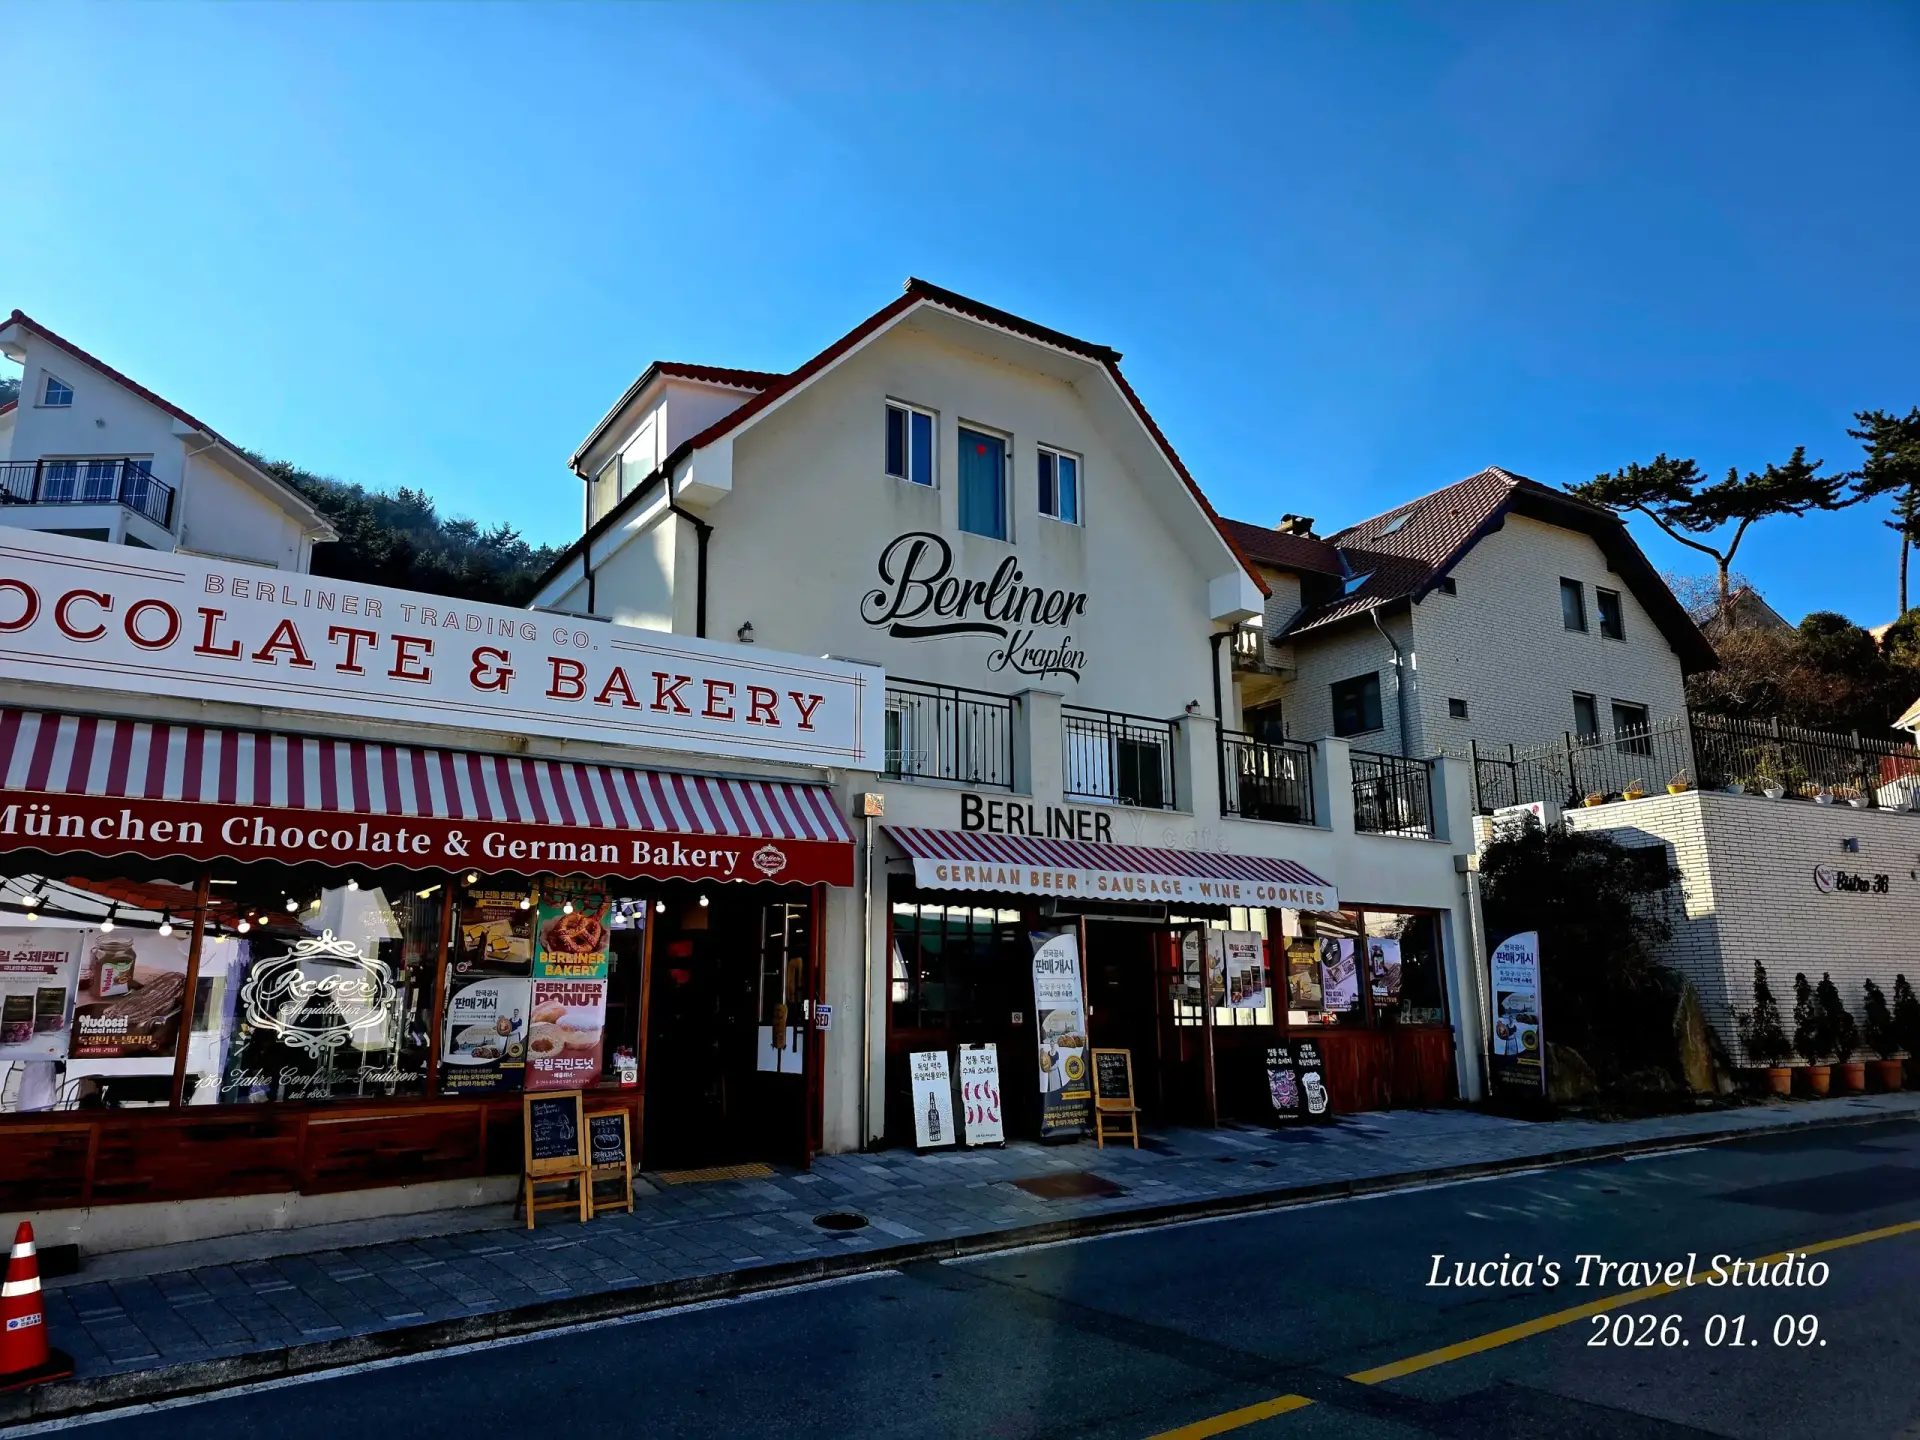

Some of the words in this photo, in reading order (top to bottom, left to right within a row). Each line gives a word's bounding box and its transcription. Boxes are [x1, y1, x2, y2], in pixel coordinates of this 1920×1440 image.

[860, 532, 1090, 638] Berliner
[205, 574, 382, 618] BERLINER
[401, 603, 537, 641] TRADING
[552, 627, 599, 650] CO.
[987, 630, 1087, 684] Krapfen
[469, 646, 515, 694] &
[545, 656, 825, 731] BAKERY
[960, 793, 1113, 844] BERLINER
[221, 816, 431, 855] Chocolate
[443, 829, 470, 857] &
[482, 831, 618, 865] German
[630, 840, 740, 876] Bakery
[935, 864, 1021, 886] GERMAN
[1030, 871, 1077, 891] BEER
[1098, 875, 1182, 897] SAUSAGE
[1199, 882, 1241, 900] WINE
[1256, 887, 1325, 907] COOKIES
[539, 952, 606, 963] BERLINER
[1496, 952, 1515, 964] 판매
[1515, 952, 1534, 965] 개시
[545, 965, 599, 976] BAKERY
[1035, 959, 1054, 974] 판매
[1055, 960, 1074, 974] 개시
[535, 983, 602, 993] BERLINER
[455, 997, 476, 1010] 판매
[477, 997, 497, 1010] 개시
[79, 1015, 129, 1027] Nudossi
[534, 1058, 554, 1071] 독일
[554, 1058, 574, 1071] 국민
[574, 1058, 594, 1070] 도넛
[917, 1063, 929, 1071] 독일
[980, 1055, 992, 1065] 독일
[195, 1077, 222, 1089] 150
[221, 1068, 272, 1092] Jahre
